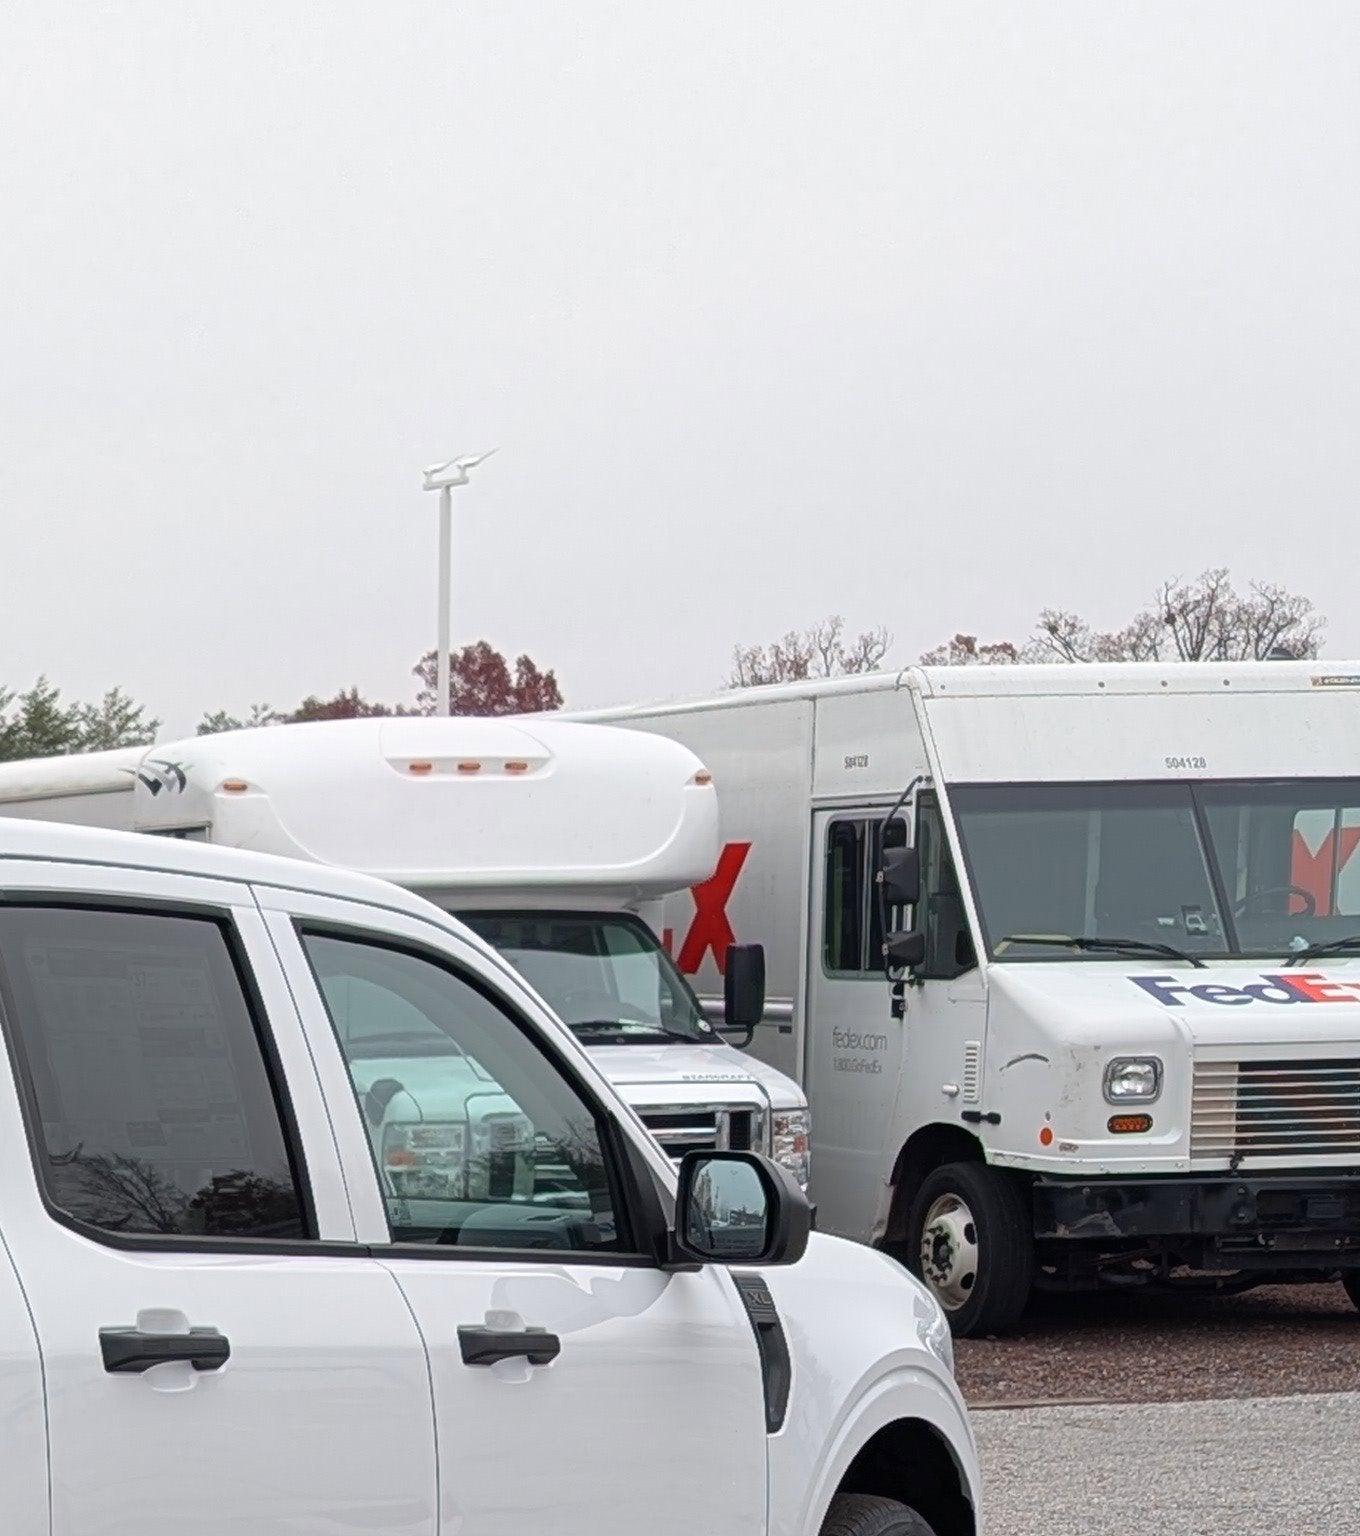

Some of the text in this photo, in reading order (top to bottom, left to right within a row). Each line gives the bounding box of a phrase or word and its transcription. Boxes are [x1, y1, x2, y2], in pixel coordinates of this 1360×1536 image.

[1164, 756, 1207, 769] 504128
[1126, 974, 1360, 1007] FedE
[832, 1025, 888, 1051] fedex.com
